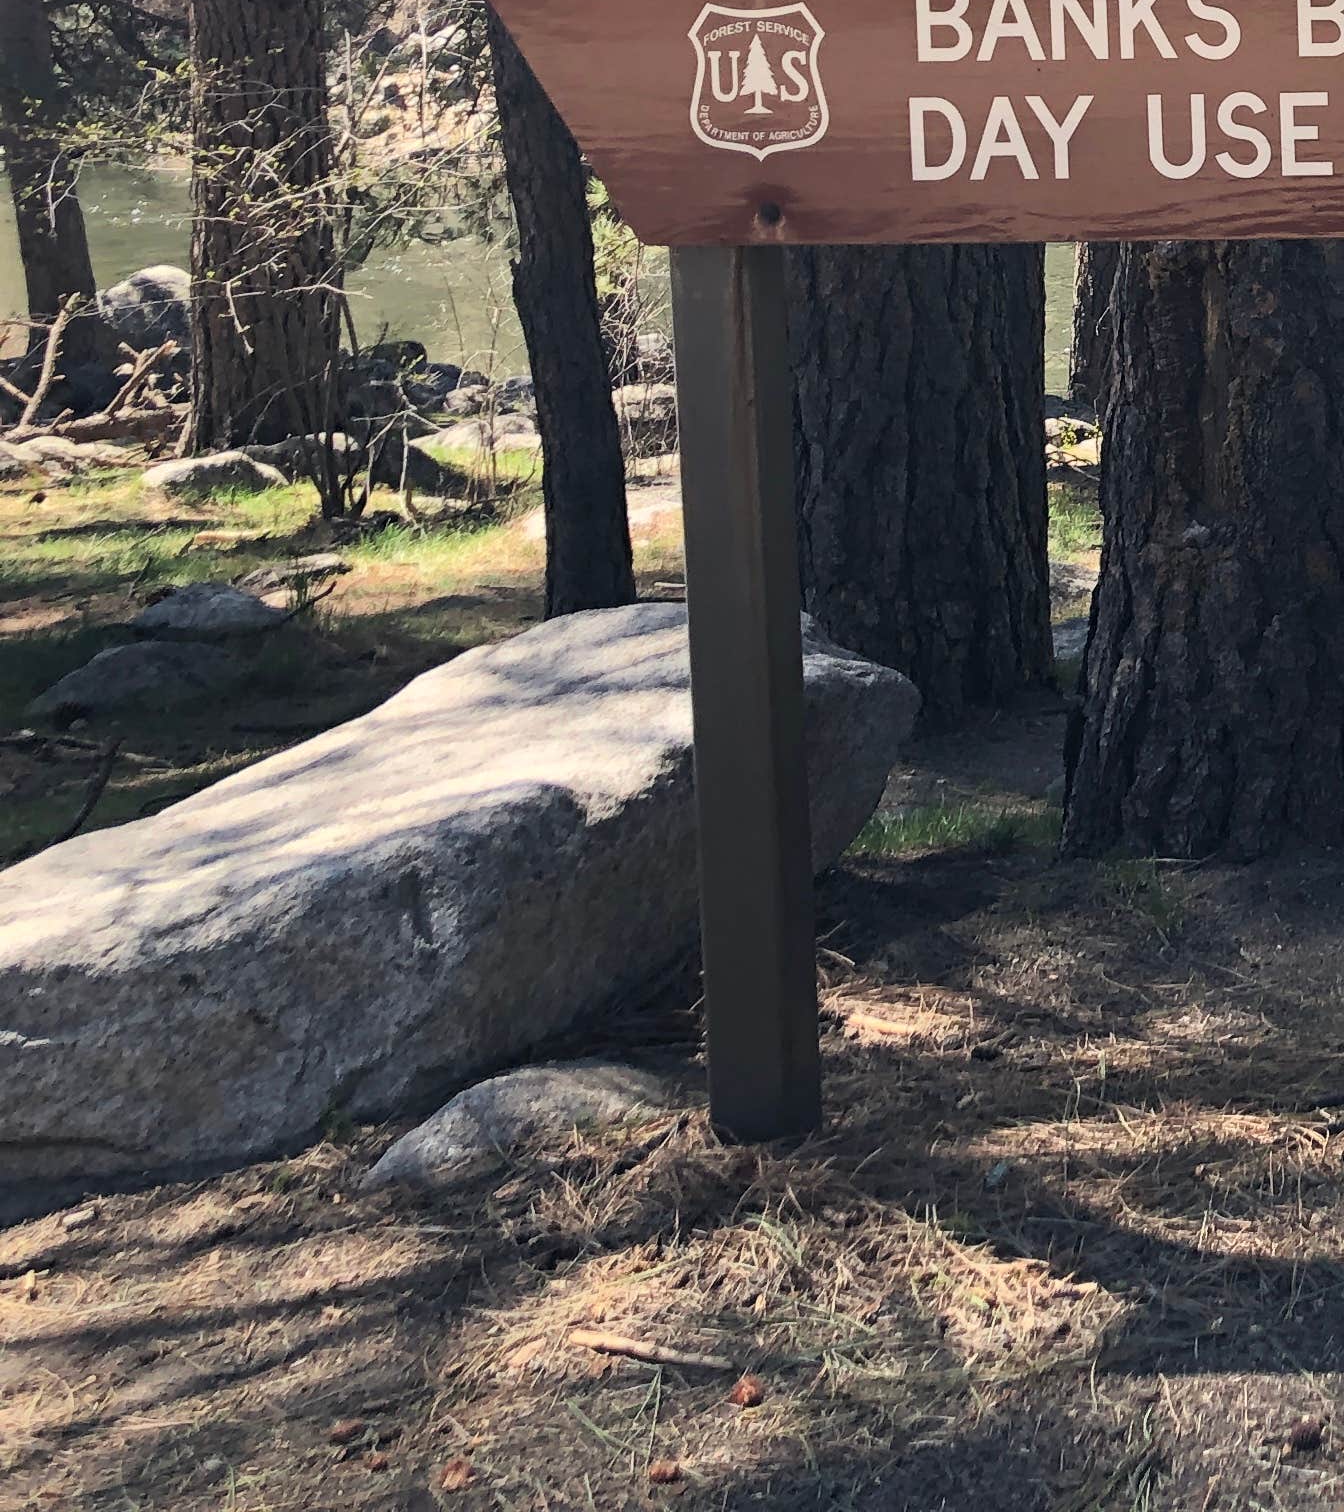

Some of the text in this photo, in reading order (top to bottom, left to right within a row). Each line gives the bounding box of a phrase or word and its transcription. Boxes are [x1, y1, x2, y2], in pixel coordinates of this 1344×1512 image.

[703, 20, 811, 47] FOREST SERVICE
[699, 104, 819, 141] DEPARTMENT OF AGRICULTURE
[908, 95, 1095, 181] DAY
[1147, 91, 1334, 180] USE
